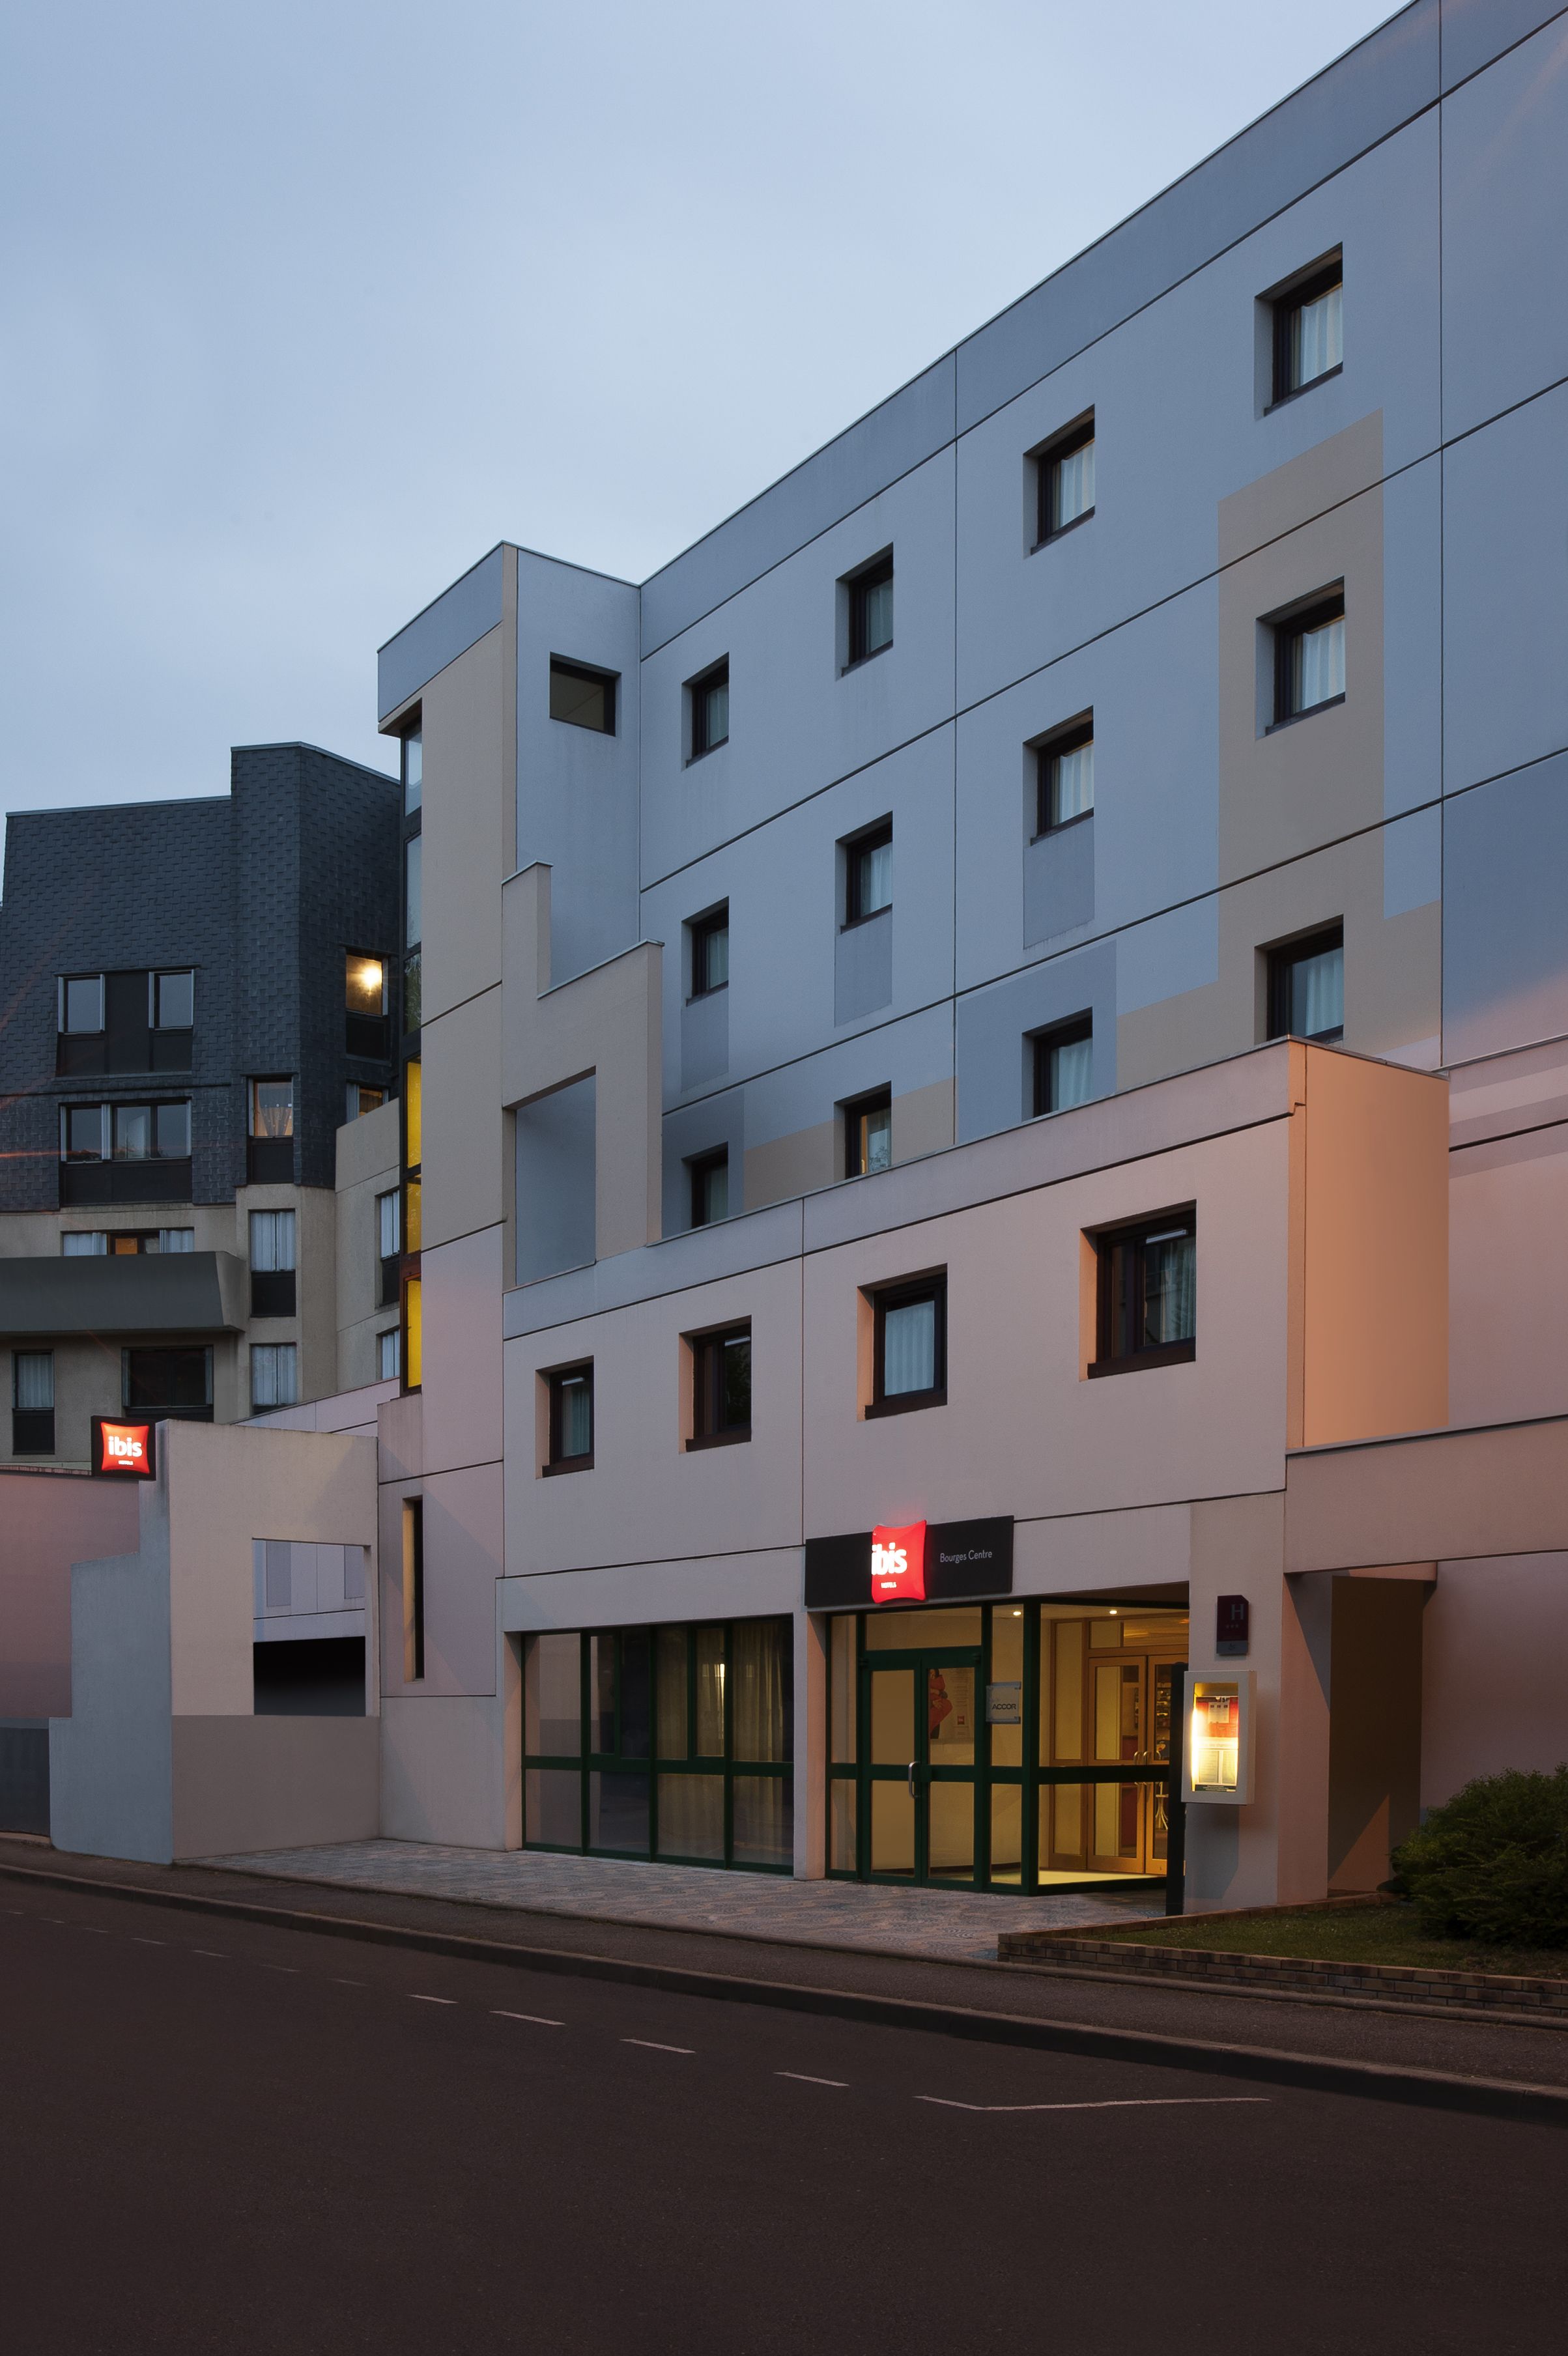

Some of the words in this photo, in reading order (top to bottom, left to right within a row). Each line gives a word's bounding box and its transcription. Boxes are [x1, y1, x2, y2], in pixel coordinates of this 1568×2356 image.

[108, 1436, 143, 1457] ibis
[871, 1542, 908, 1575] ibis
[940, 1553, 967, 1563] Bourges
[968, 1550, 993, 1560] Centre
[1231, 1604, 1244, 1620] H
